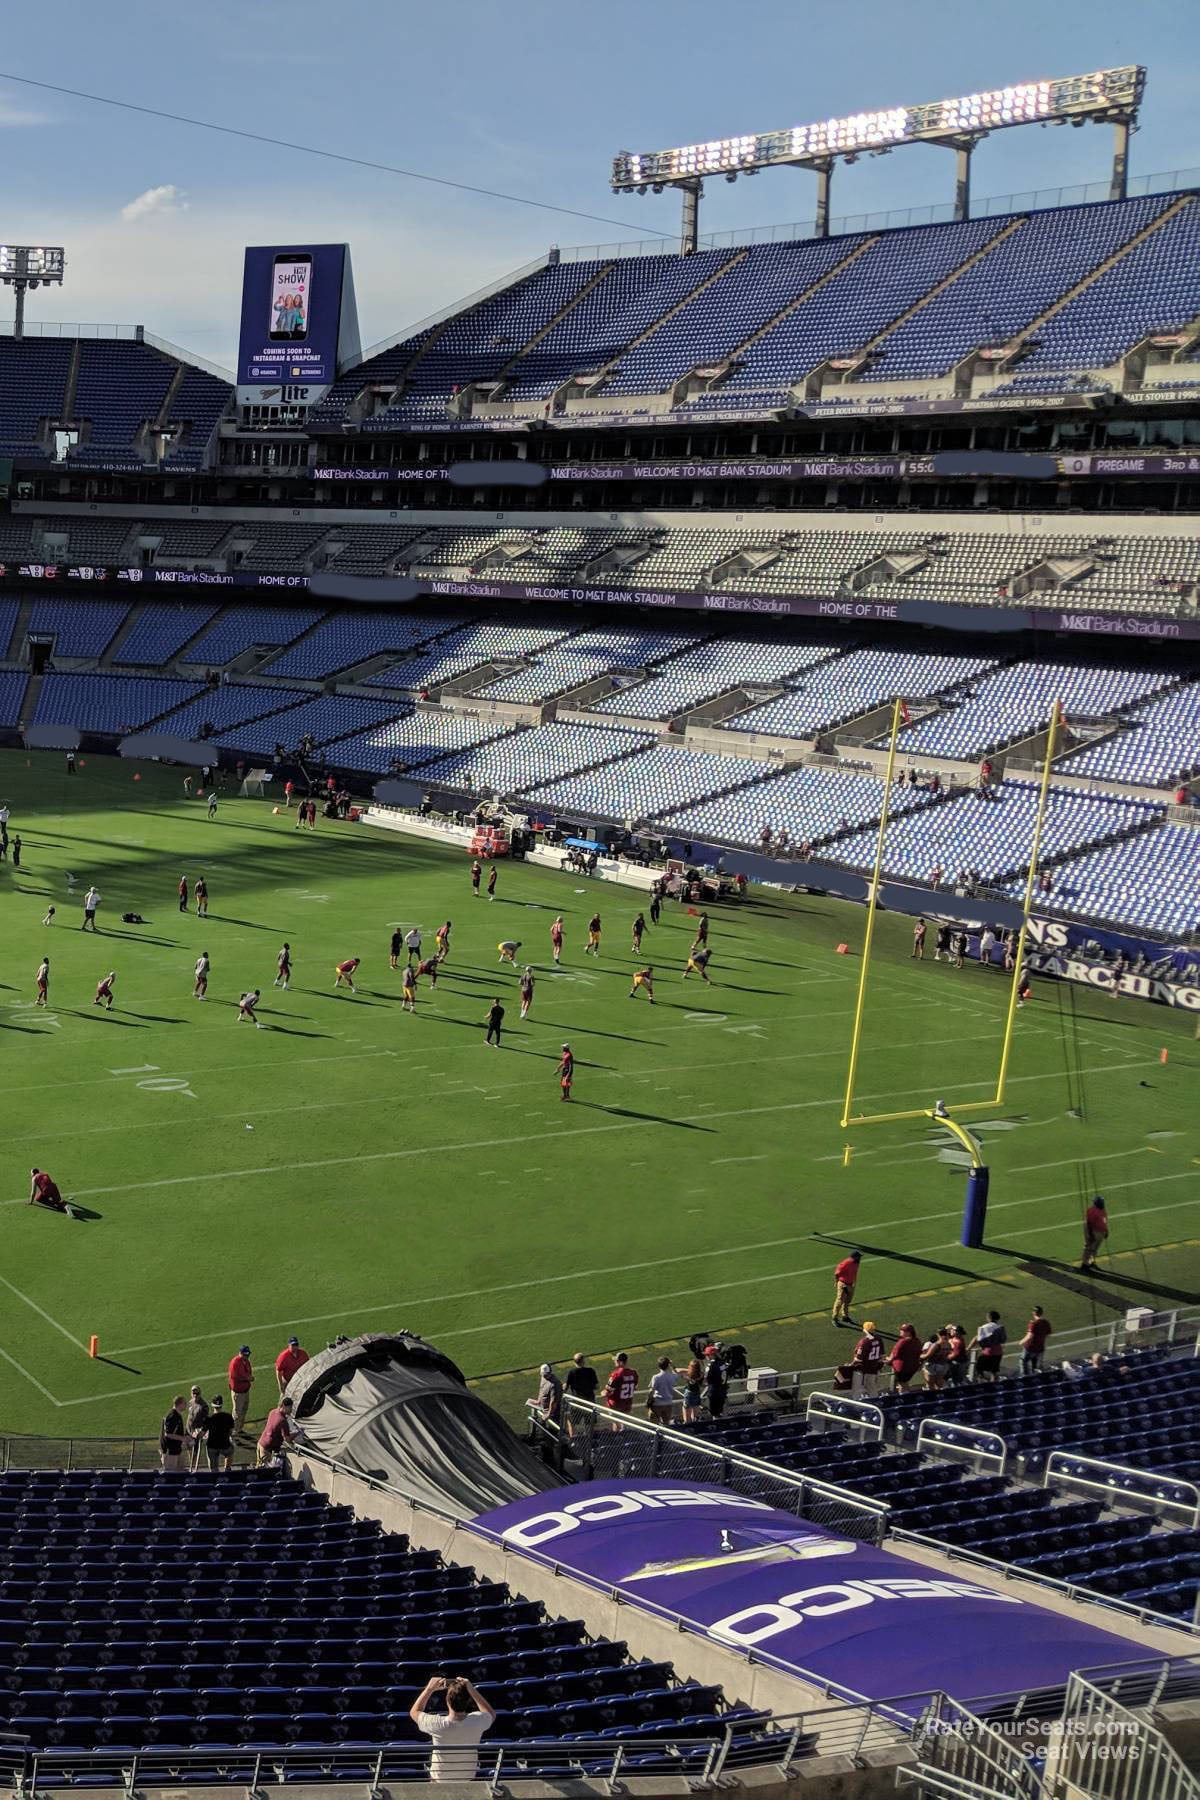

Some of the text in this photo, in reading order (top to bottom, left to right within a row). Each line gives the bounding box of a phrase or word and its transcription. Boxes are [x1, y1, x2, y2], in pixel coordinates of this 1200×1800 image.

[278, 274, 305, 284] SHOW
[281, 385, 309, 403] Lite
[1145, 392, 1175, 400] STOVER
[961, 398, 1065, 410] JONATHAN OGDEN 1996-2007
[835, 407, 869, 415] BOULWARE
[803, 462, 894, 475] M&T Bank Stadium
[1073, 460, 1083, 472] 0
[1097, 460, 1145, 471] PREGAME
[1163, 458, 1200, 470] 3RD &
[313, 468, 389, 480] M&T Bank Stadium
[397, 470, 424, 479] HOME
[425, 470, 438, 479] OF
[550, 467, 623, 479] M&T Bank Stadium
[633, 465, 791, 477] WELCOME TO M&T BANK STADIUM
[155, 571, 234, 584] M&T Bank Stadium
[258, 575, 285, 585] HOME
[287, 576, 300, 586] OF
[432, 582, 500, 595] M&T Bank Stadium
[525, 587, 676, 604] WELCOME TO M&T BANK STADIUM
[704, 596, 791, 612] M&T Bank Stadium
[819, 602, 897, 617] HOME OF THE
[1060, 614, 1180, 636] M&T Bank Stadium
[868, 1346, 880, 1360] 21
[620, 1383, 635, 1399] 21
[501, 1490, 775, 1546] GEICO
[707, 1578, 1024, 1646] GEICO
